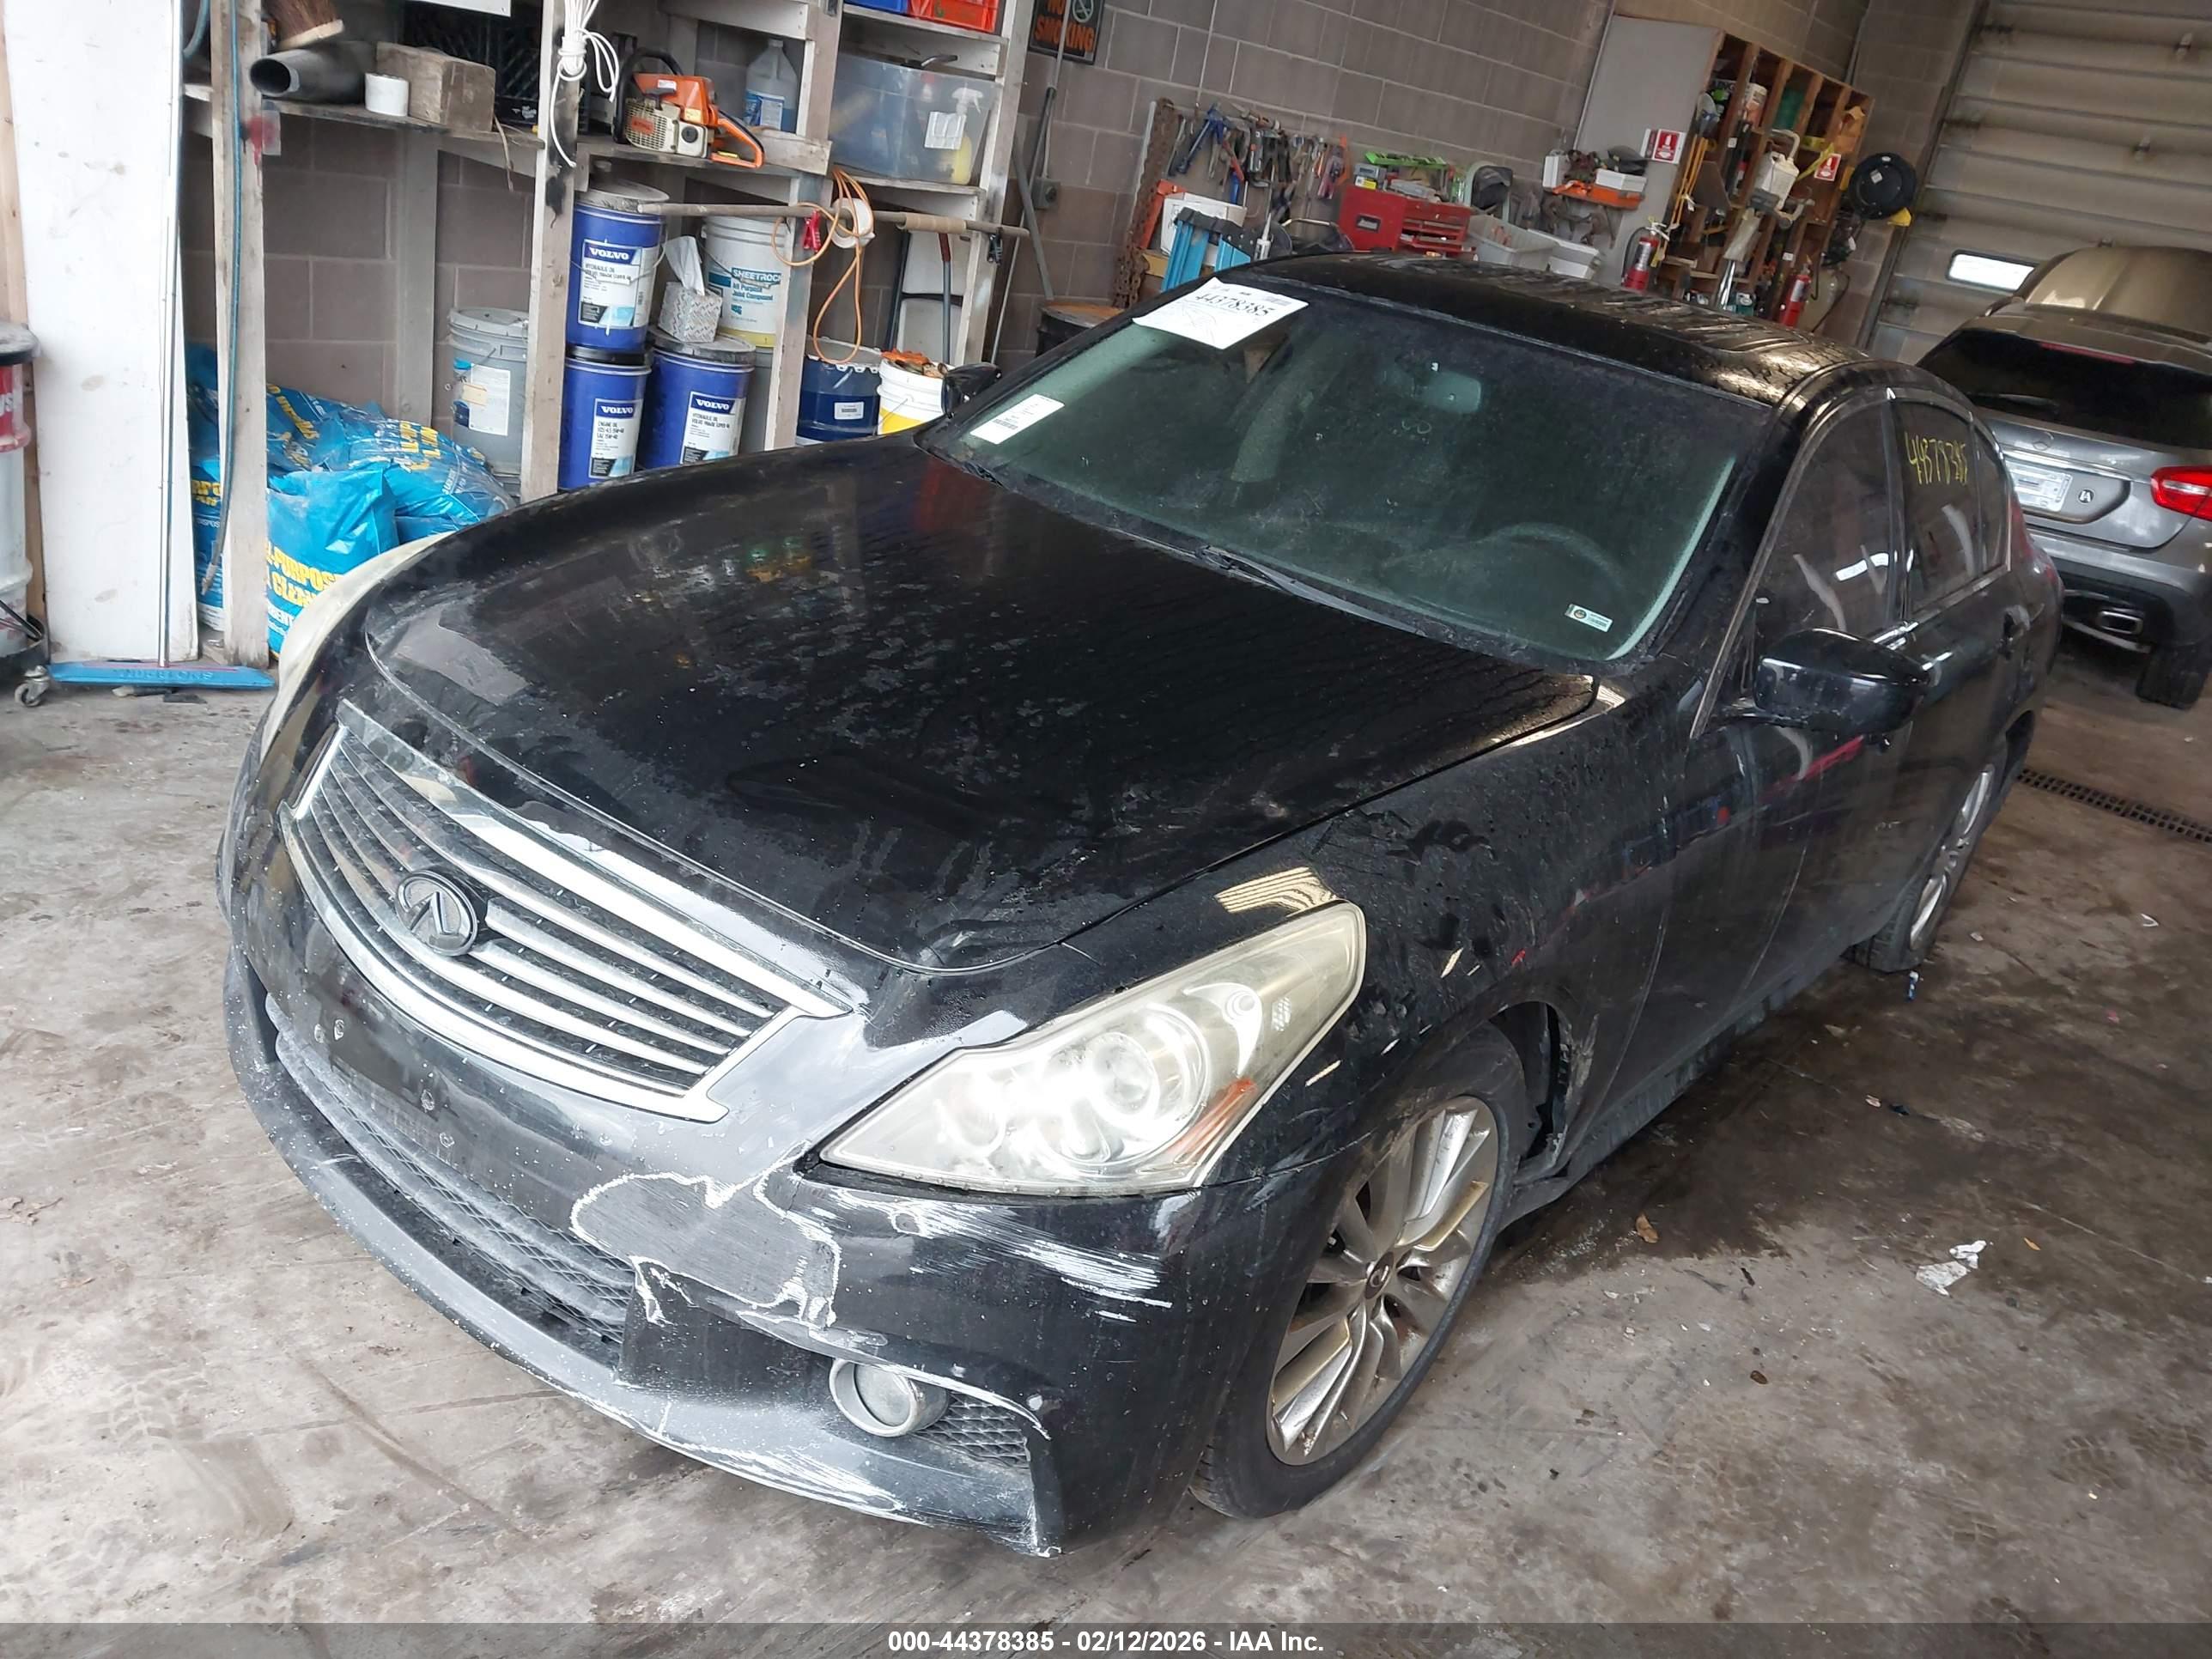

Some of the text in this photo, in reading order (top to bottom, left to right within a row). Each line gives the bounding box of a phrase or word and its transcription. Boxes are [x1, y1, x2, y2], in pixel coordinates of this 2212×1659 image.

[1035, 15, 1095, 52] SMOKING
[589, 246, 629, 260] VOLVO
[600, 405, 634, 414] VOLVO
[695, 398, 730, 410] VOLVO
